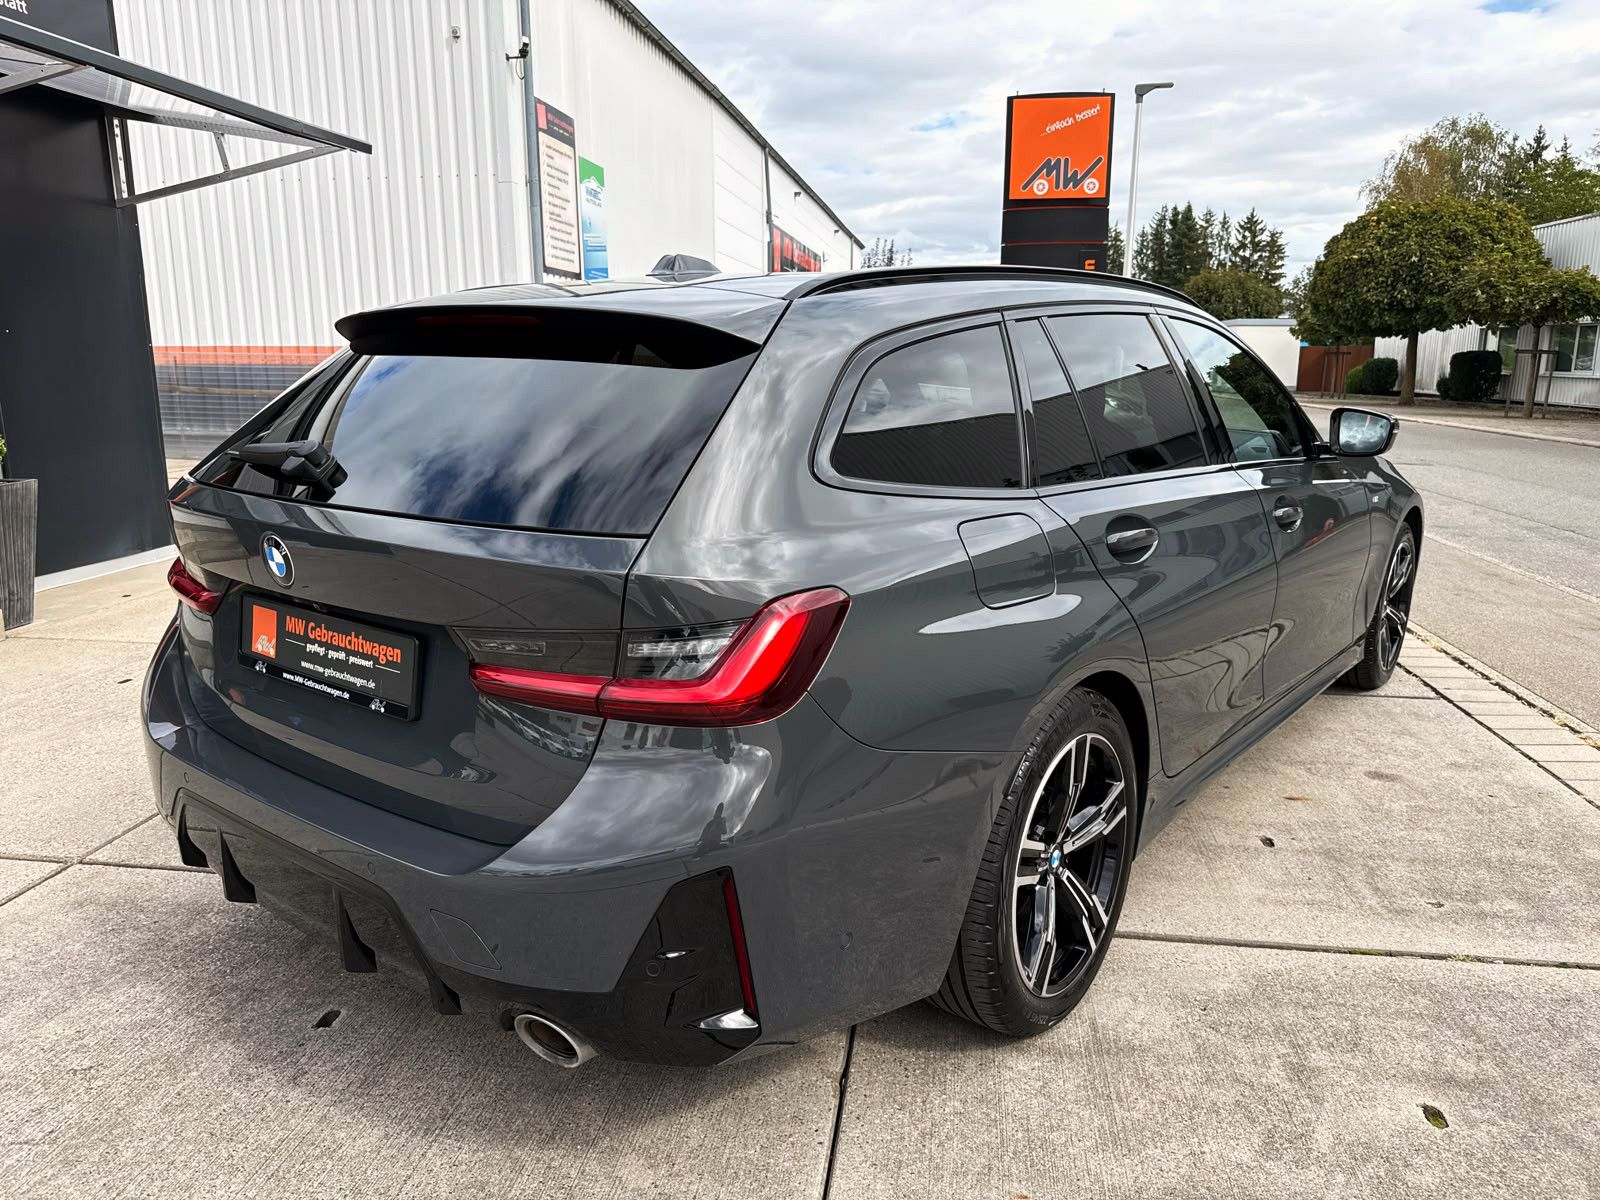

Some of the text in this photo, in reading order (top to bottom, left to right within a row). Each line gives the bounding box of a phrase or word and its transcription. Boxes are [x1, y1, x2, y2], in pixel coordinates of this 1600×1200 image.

[1021, 157, 1103, 192] MW
[285, 615, 401, 664] MW Gebrauchtwagen
[300, 660, 376, 690] www.mw-gebrauchtwagen.de
[349, 655, 374, 668] preiswert
[282, 672, 350, 700] www.MW-Gebrauchtwagen.de
